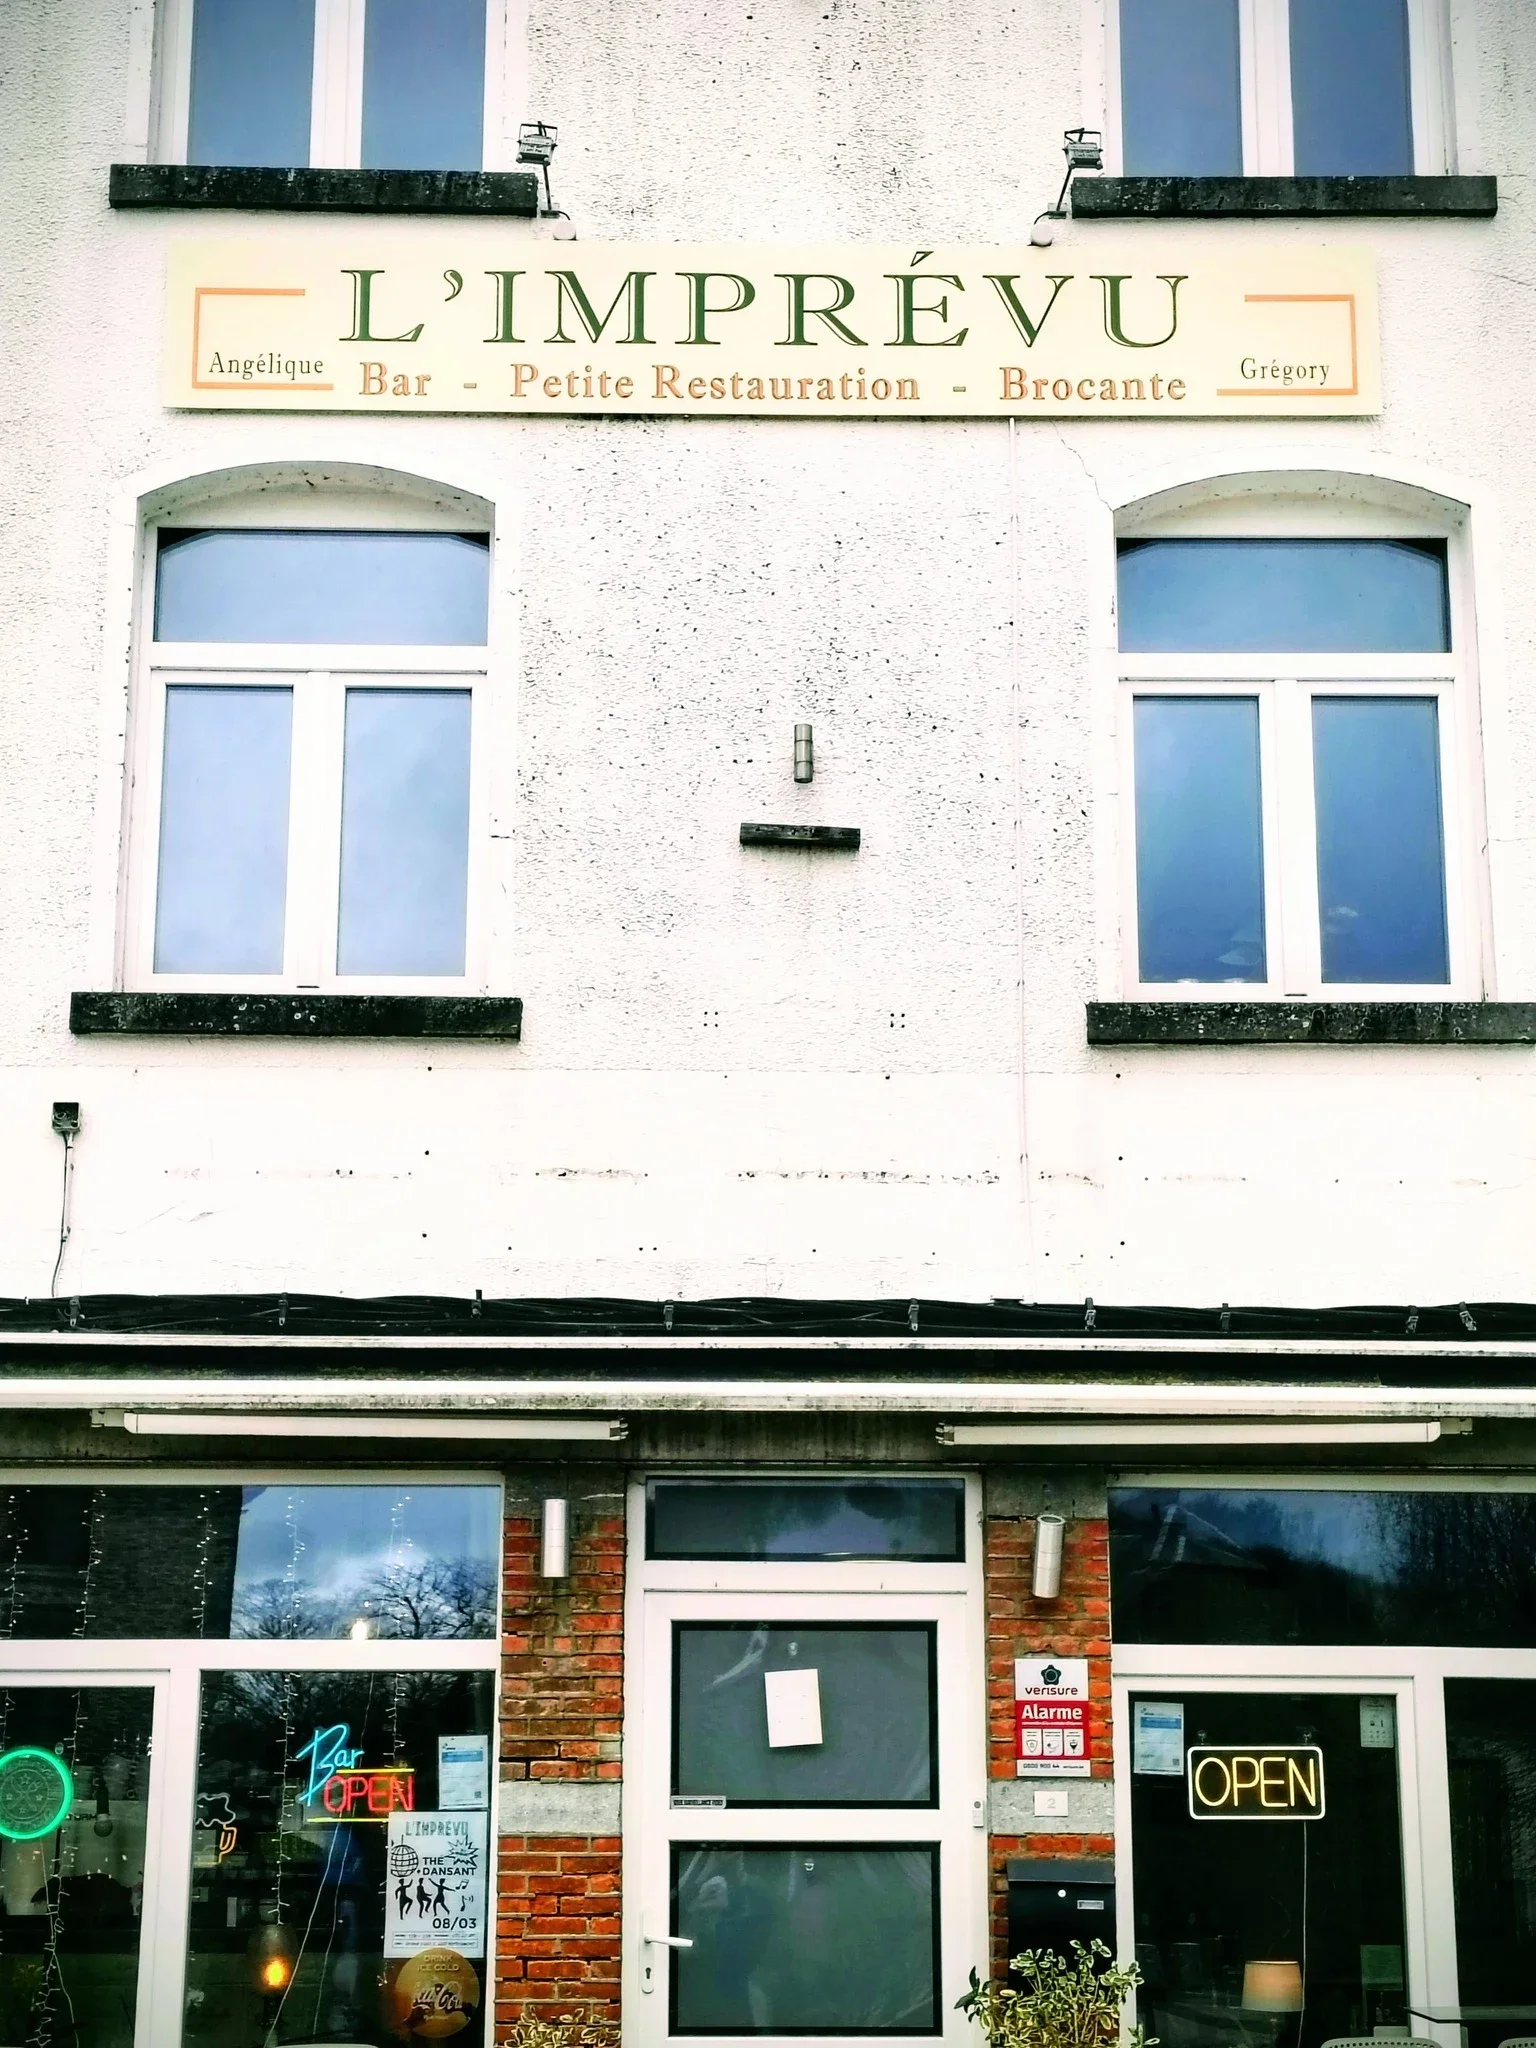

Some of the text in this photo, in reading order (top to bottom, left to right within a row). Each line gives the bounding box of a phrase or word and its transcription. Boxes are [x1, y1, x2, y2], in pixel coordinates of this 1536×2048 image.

[338, 250, 1189, 348] L'IMPRÉVU
[208, 351, 325, 380] Angélique
[1239, 357, 1331, 386] Grégory
[359, 361, 431, 397] Bar
[510, 363, 634, 399] Petite
[651, 364, 920, 400] Restauration
[998, 366, 1187, 401] Brocante
[1024, 1686, 1079, 1696] verisure
[1021, 1703, 1084, 1721] Alarme
[296, 1724, 365, 1806] Bar
[1194, 1756, 1316, 1807] OPEN
[323, 1774, 415, 1813] OPEN
[1046, 1797, 1057, 1809] 2
[422, 1866, 477, 1877] DANSANT
[432, 1917, 478, 1932] 08/03
[423, 1954, 454, 1963] DRINK
[433, 1963, 460, 1972] COLD
